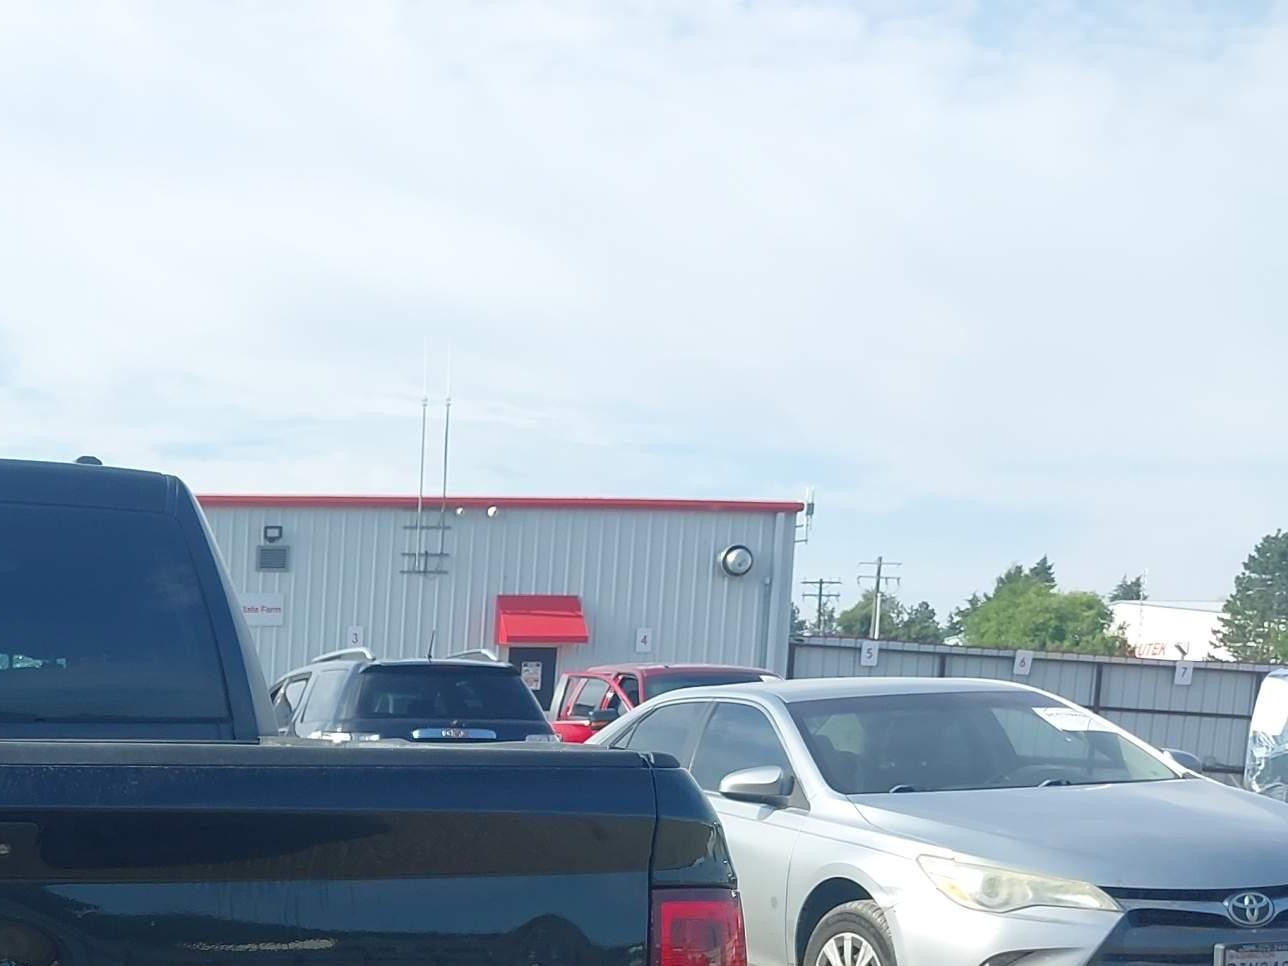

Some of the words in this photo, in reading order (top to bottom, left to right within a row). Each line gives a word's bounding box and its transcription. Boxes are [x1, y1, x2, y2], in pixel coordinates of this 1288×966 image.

[351, 631, 359, 644] 3
[640, 634, 648, 646] 4
[866, 647, 874, 660] 5
[1128, 642, 1167, 657] UTEK
[1019, 656, 1026, 668] 6
[1180, 666, 1188, 678] 7
